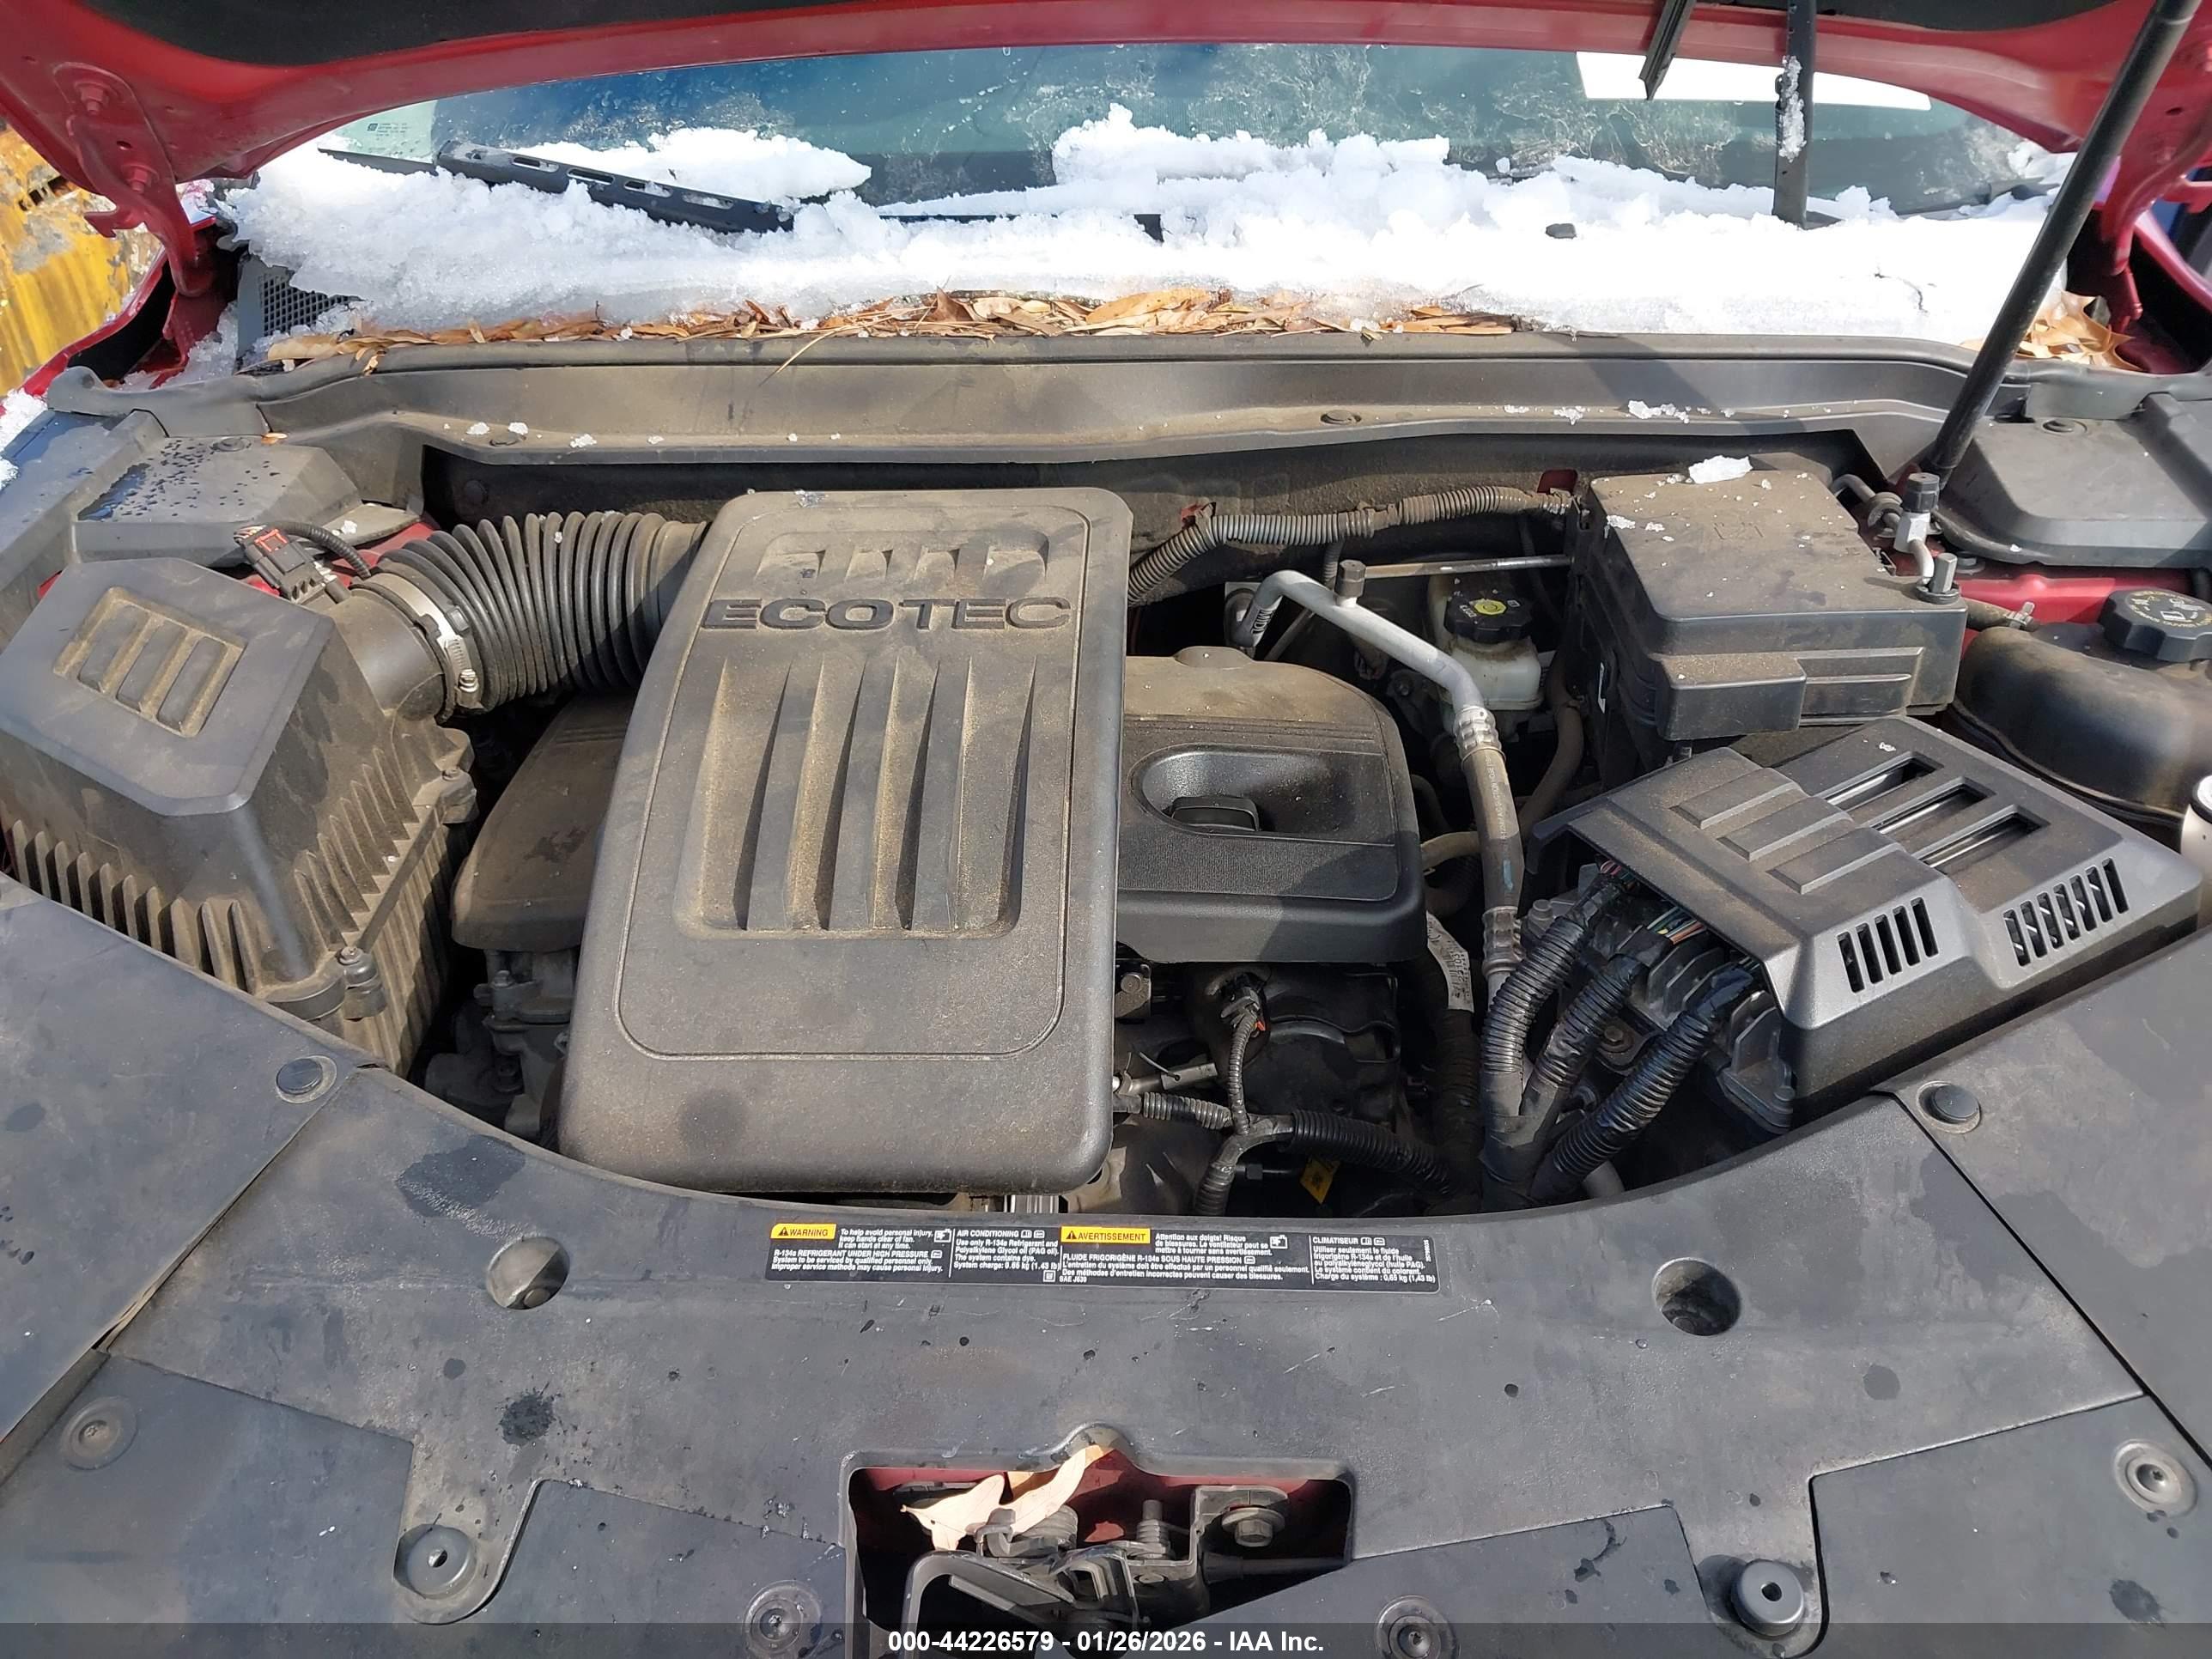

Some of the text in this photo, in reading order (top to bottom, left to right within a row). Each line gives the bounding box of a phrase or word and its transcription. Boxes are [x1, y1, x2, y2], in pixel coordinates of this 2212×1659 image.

[702, 599, 1070, 629] ECOTEC
[1078, 1233, 1146, 1241] AVERTISSEMENT
[1089, 1253, 1136, 1262] FRIGORIGÈNE
[893, 1264, 921, 1272] personal
[954, 1261, 978, 1270] System
[1021, 1262, 1029, 1271] kg
[1184, 1271, 1210, 1280] peuvent
